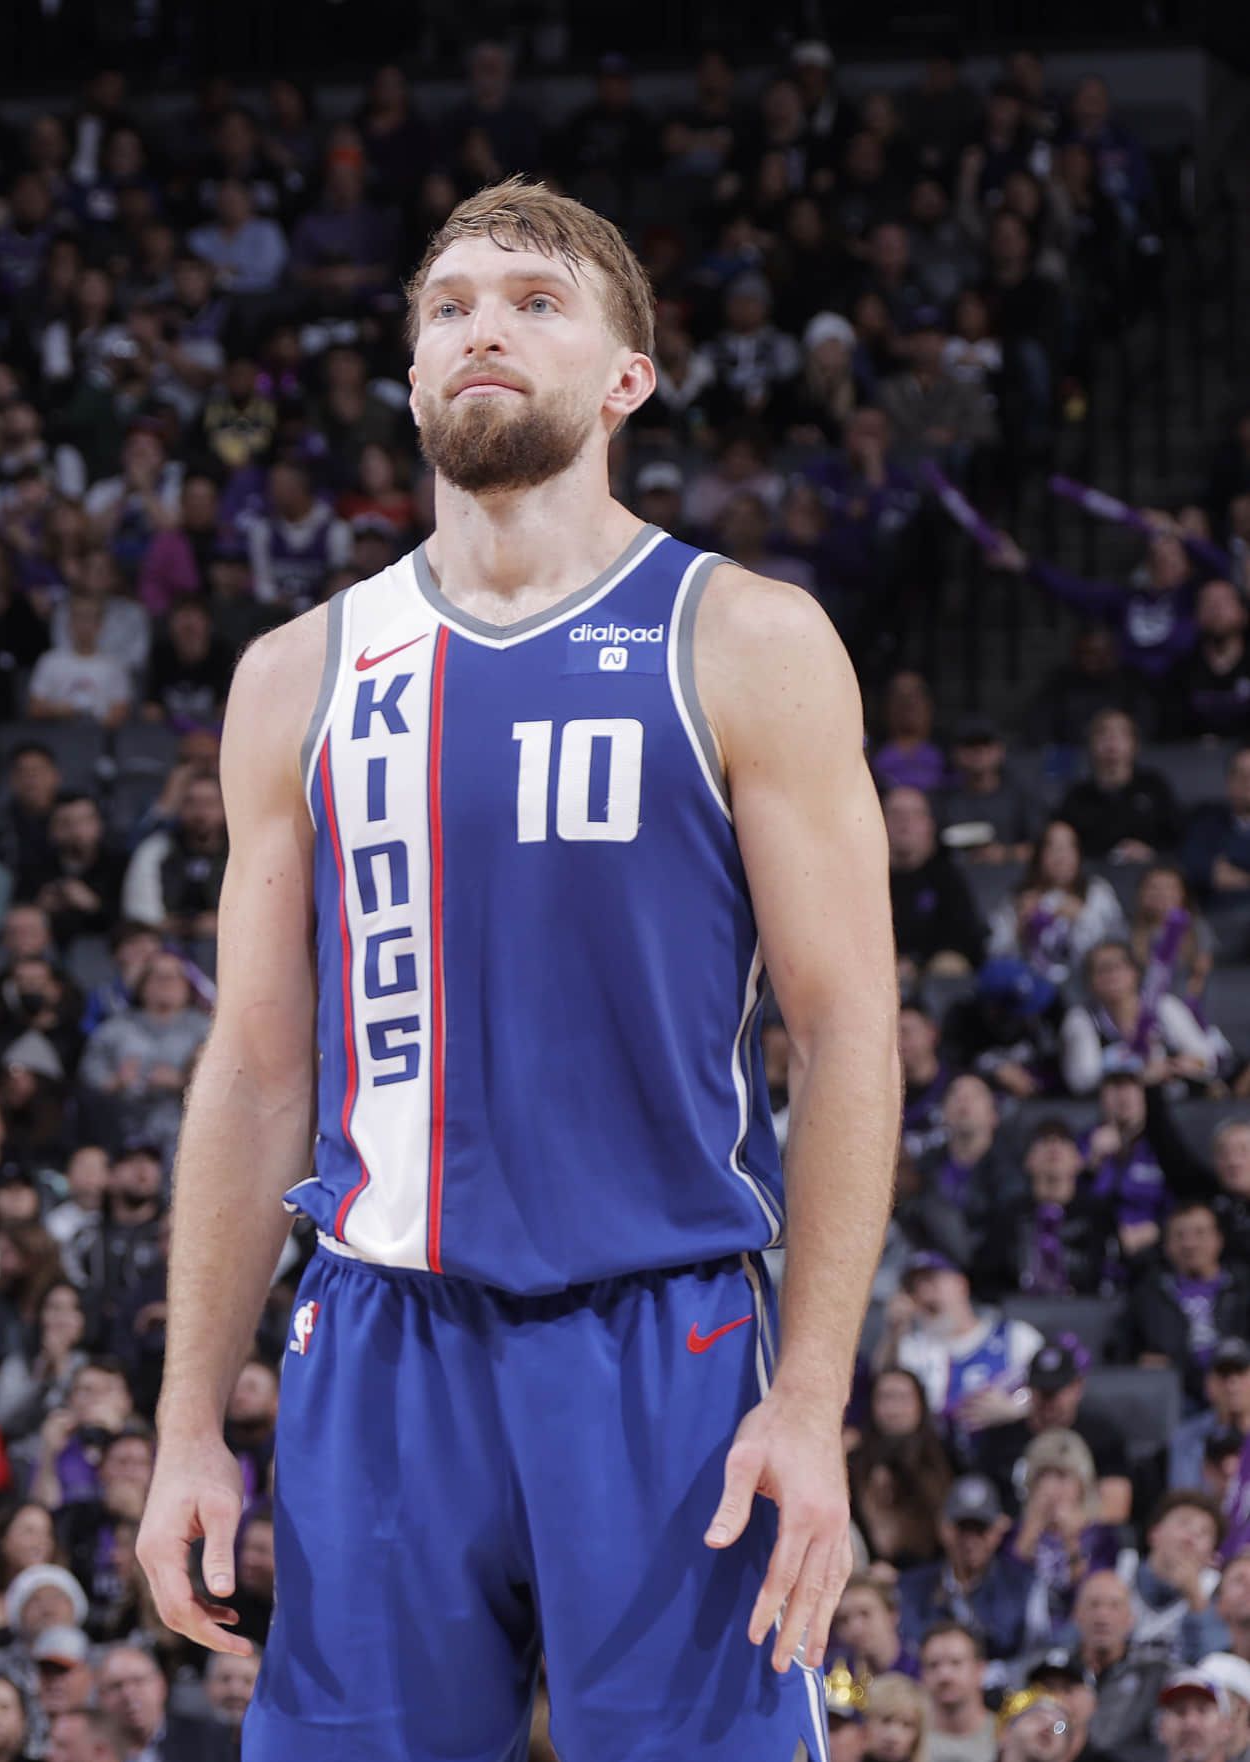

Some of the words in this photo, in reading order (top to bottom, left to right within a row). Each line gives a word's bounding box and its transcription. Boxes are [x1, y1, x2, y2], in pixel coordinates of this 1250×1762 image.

[569, 623, 664, 645] dialpad
[512, 718, 644, 843] 10
[350, 672, 421, 1088] KINGS
